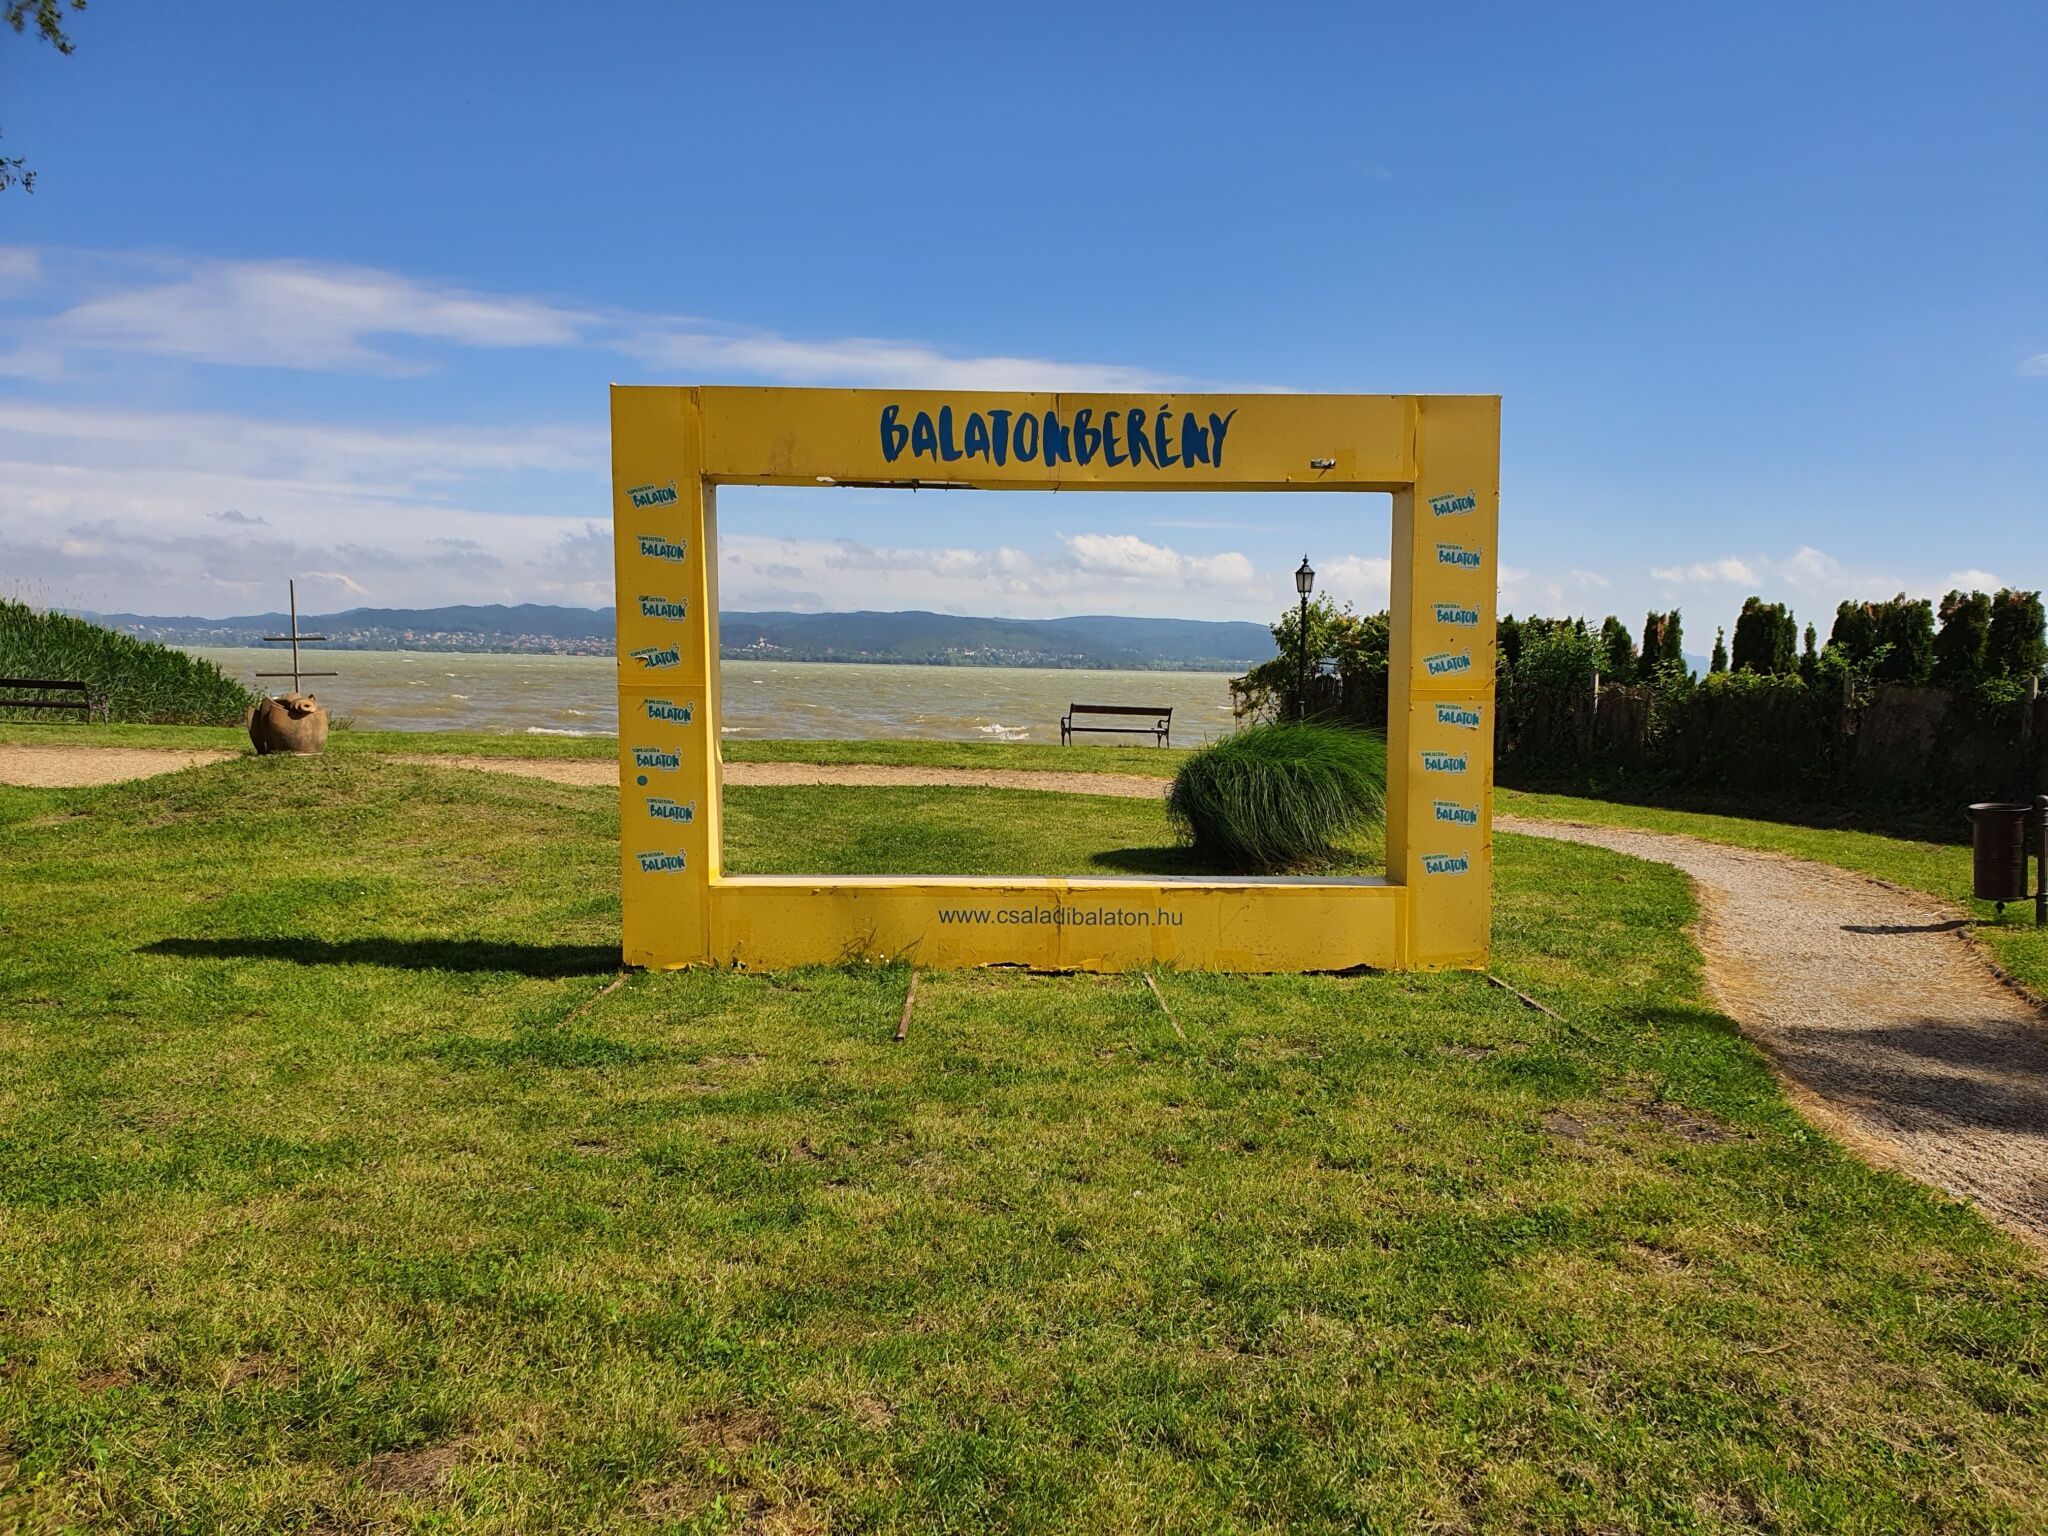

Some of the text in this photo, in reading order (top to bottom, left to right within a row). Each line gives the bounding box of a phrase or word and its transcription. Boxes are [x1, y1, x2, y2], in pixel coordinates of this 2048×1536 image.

[881, 403, 1238, 470] BALATONBERÉNY
[633, 488, 677, 507] BALATON
[1433, 498, 1475, 516] BALATON
[641, 543, 684, 558] BALATON
[1439, 550, 1479, 565] BALATON
[642, 603, 685, 618] BALATON
[1437, 610, 1478, 623] BALATON
[1428, 655, 1470, 675] BALATON
[648, 706, 691, 721] BALATON
[1438, 710, 1479, 725] BALATON
[636, 754, 679, 768] BALATON
[1425, 758, 1466, 771] BALATON
[650, 804, 692, 819] BALATON
[1436, 808, 1476, 822] BALATON
[642, 858, 685, 872] BALATON
[1426, 858, 1467, 873] BALATON
[938, 906, 1184, 926] www.csaladibalaton.hu
